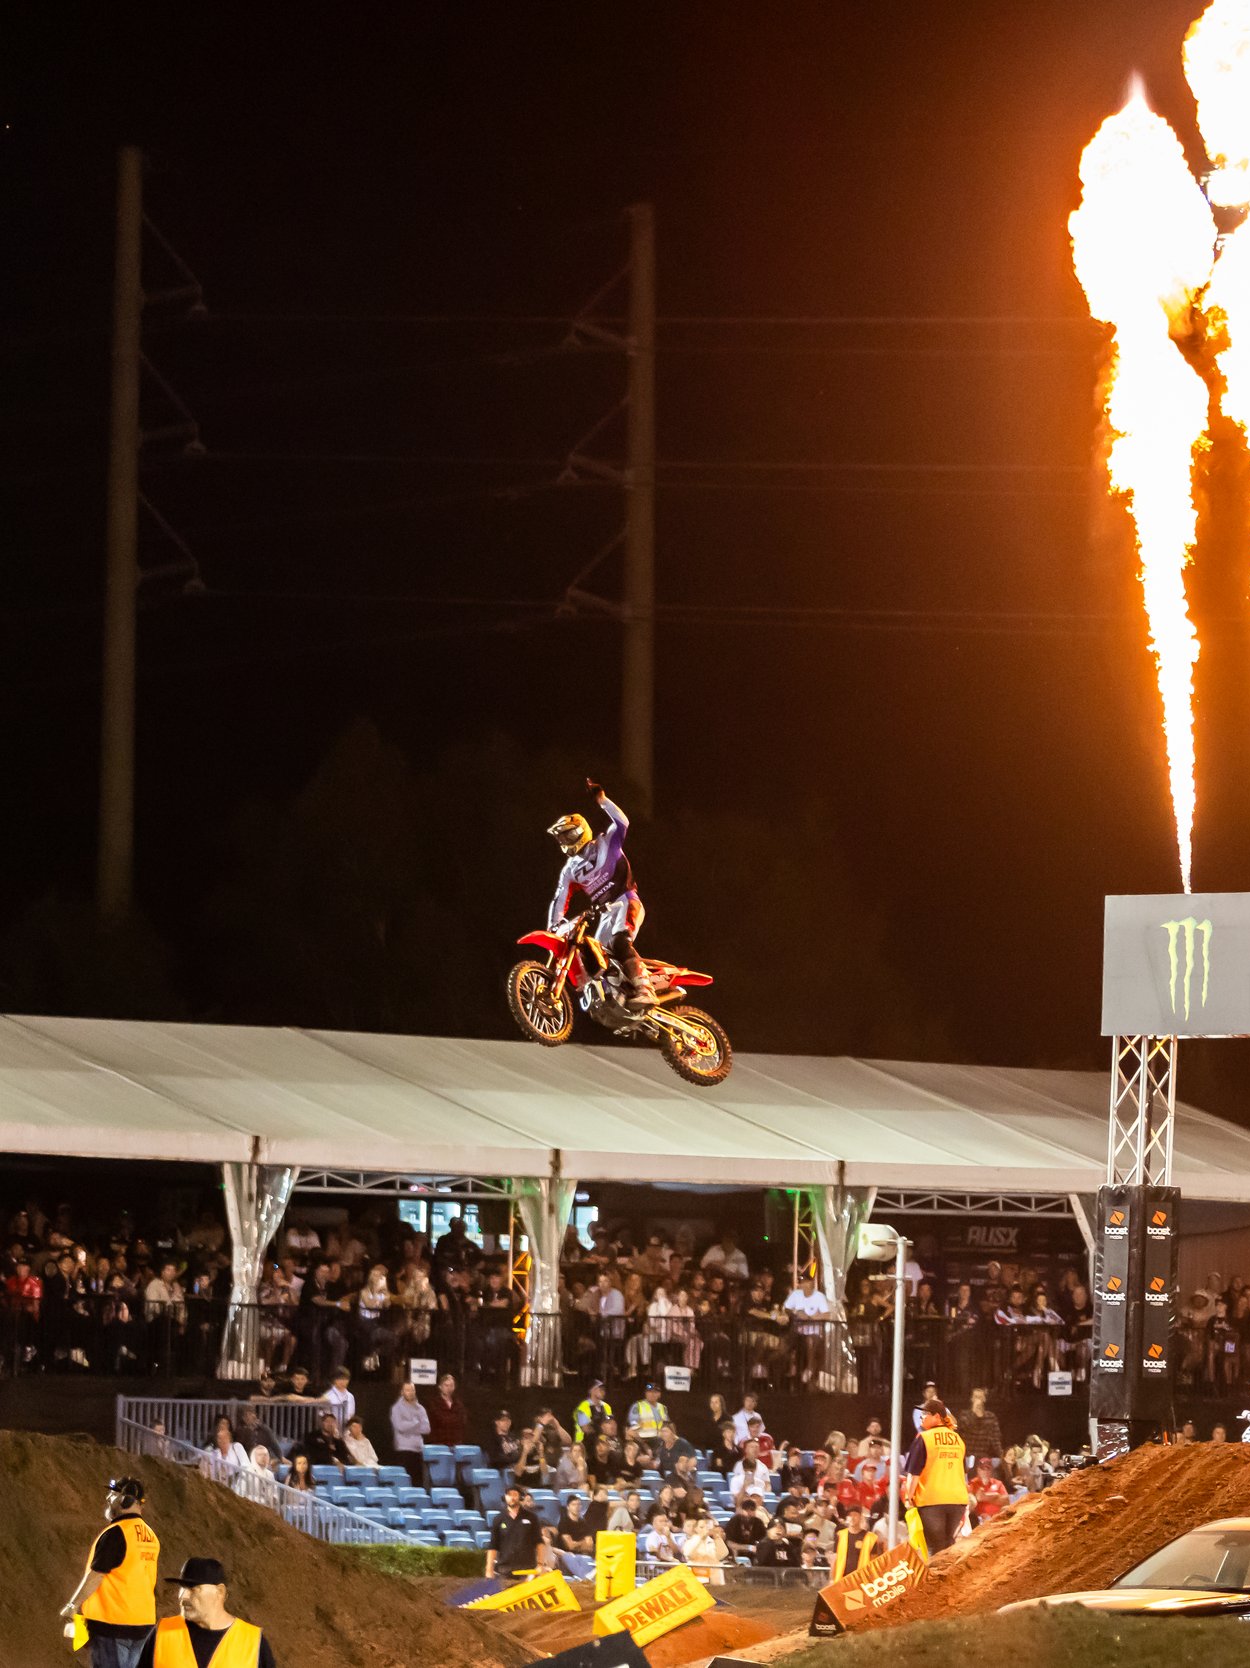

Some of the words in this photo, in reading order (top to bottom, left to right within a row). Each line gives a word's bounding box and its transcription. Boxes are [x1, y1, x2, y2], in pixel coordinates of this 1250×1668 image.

[1104, 1226, 1128, 1235] boost
[1147, 1226, 1171, 1235] boost
[966, 1226, 1020, 1247] AUSX
[1102, 1292, 1126, 1301] boost
[1145, 1292, 1169, 1302] boost
[1099, 1358, 1124, 1368] boost
[1143, 1359, 1167, 1369] boost
[934, 1432, 960, 1446] AUSX
[860, 1559, 914, 1598] boost
[872, 1584, 907, 1608] mobile
